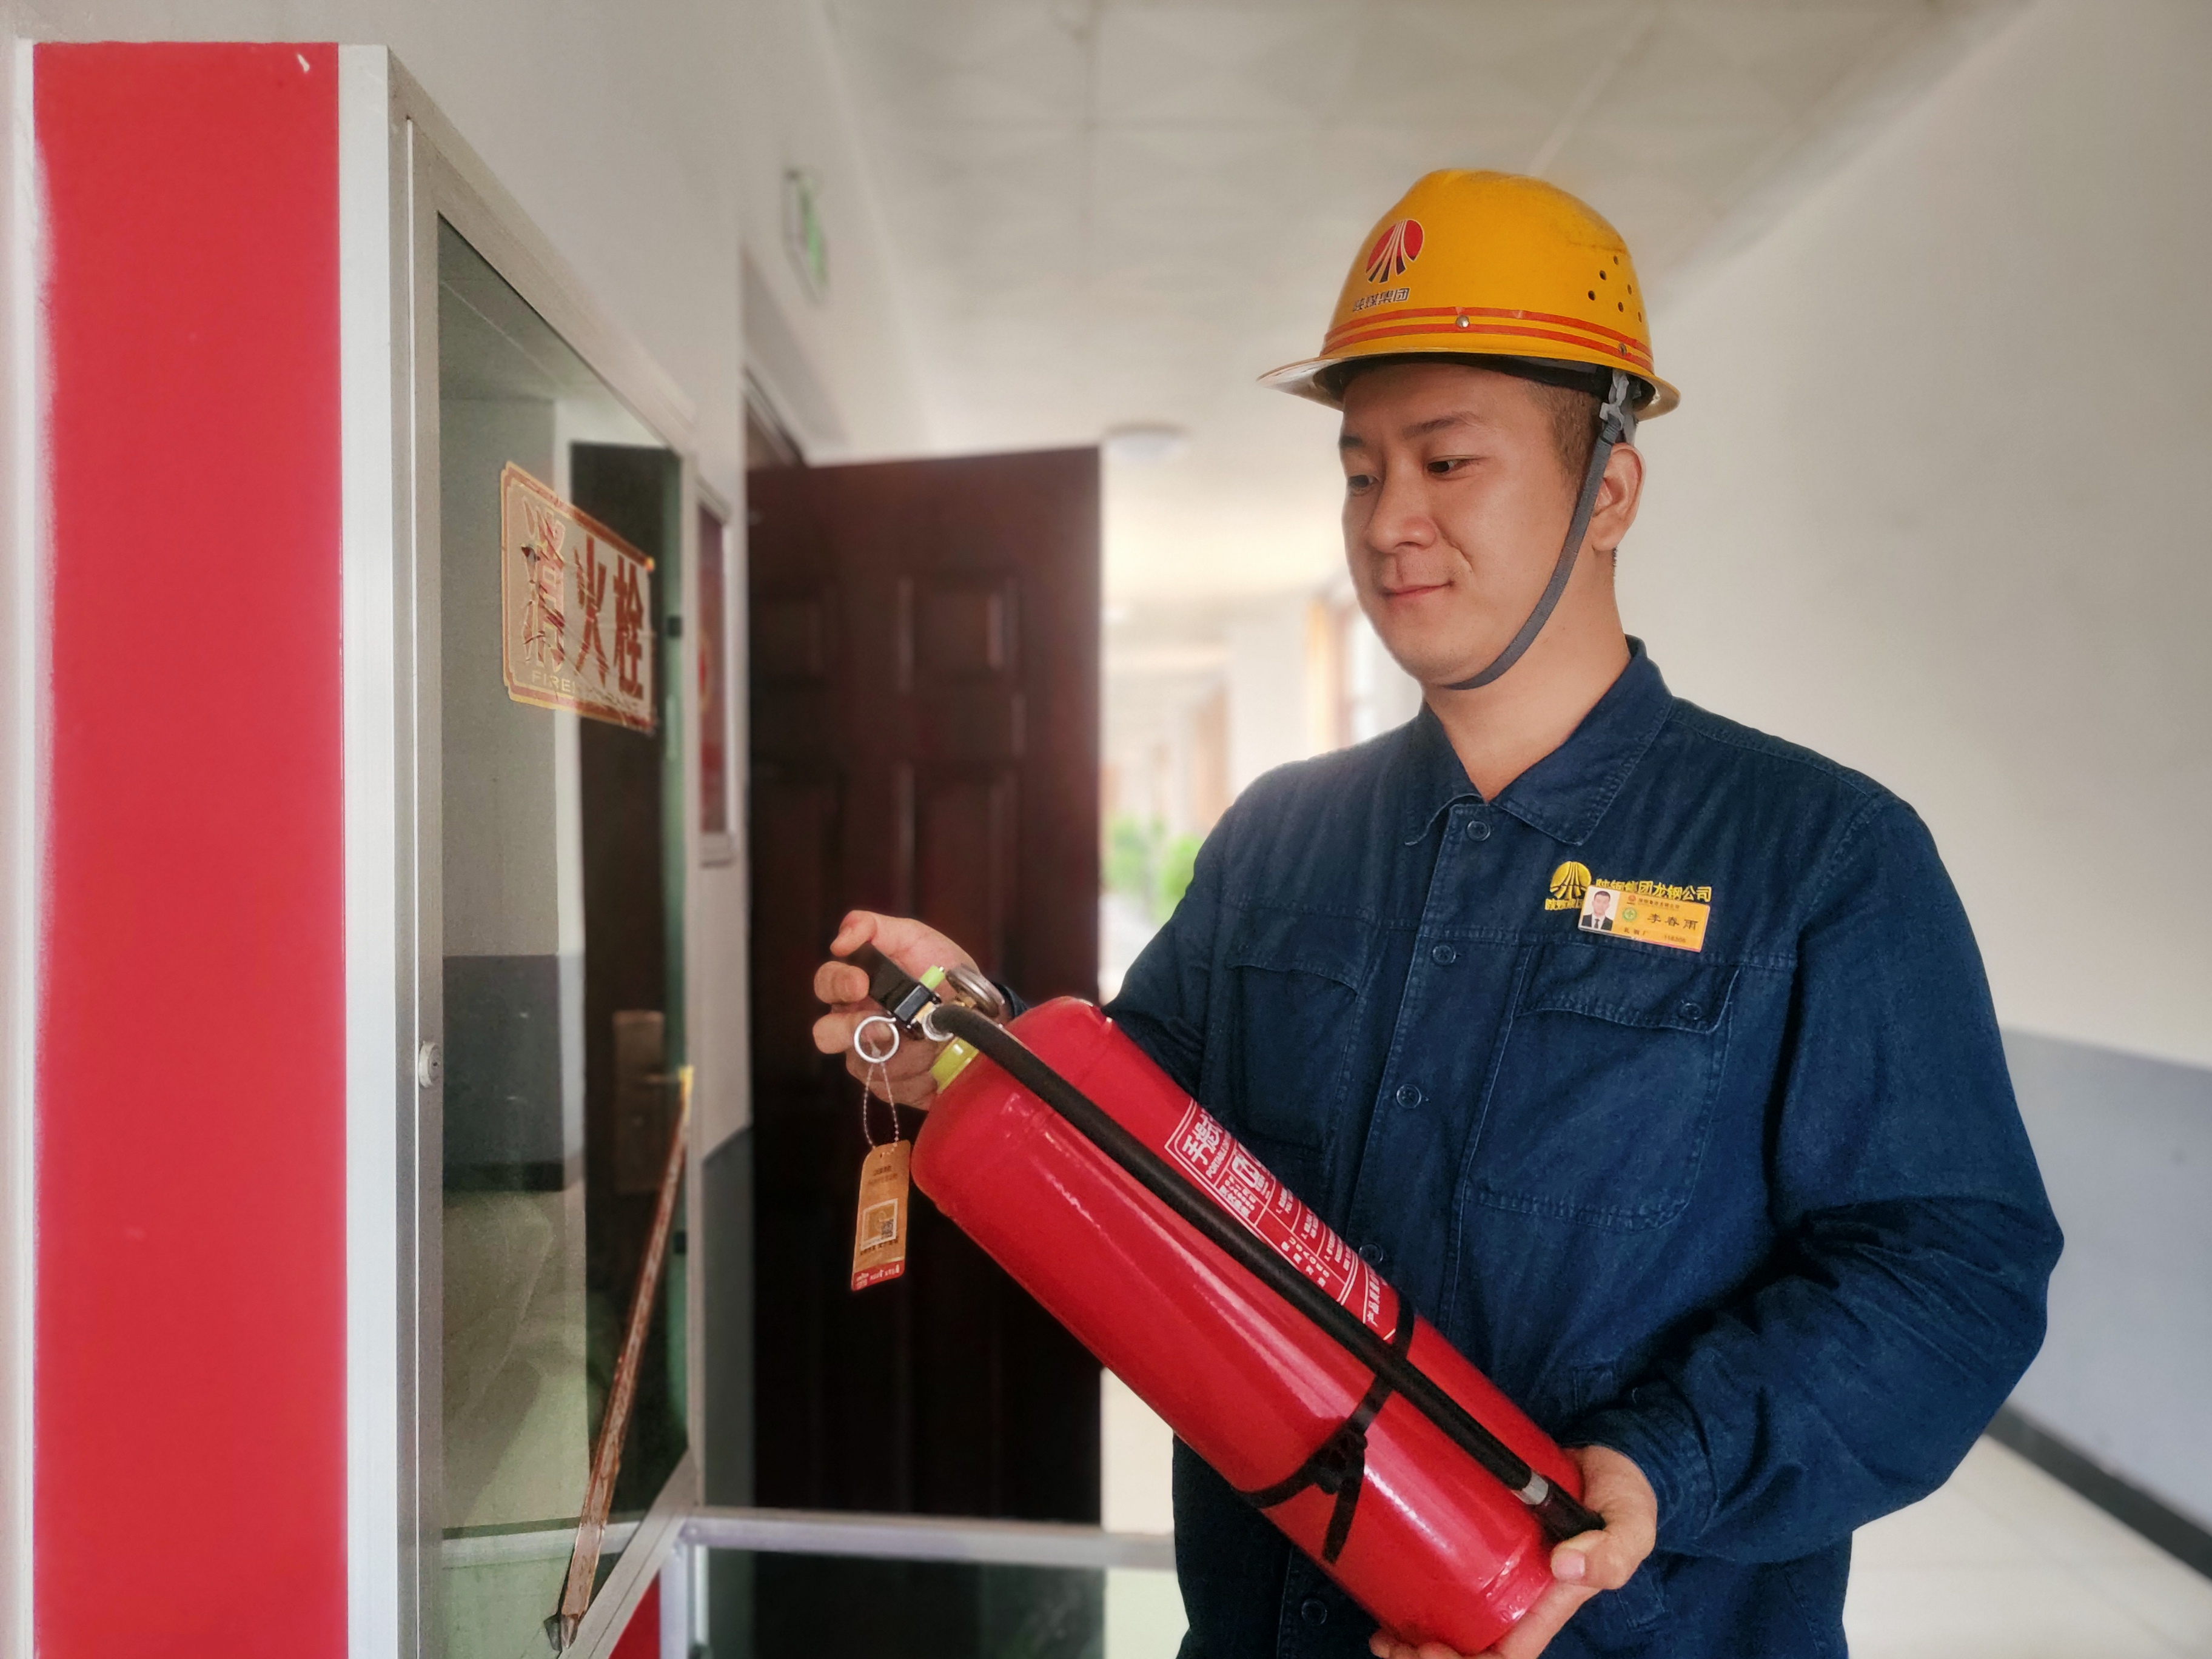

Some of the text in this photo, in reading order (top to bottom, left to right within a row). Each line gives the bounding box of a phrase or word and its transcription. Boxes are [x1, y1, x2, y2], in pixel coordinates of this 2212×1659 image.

[521, 495, 644, 700] 消火栓
[532, 669, 571, 693] FIRE
[1647, 913, 1699, 931] 李春雨
